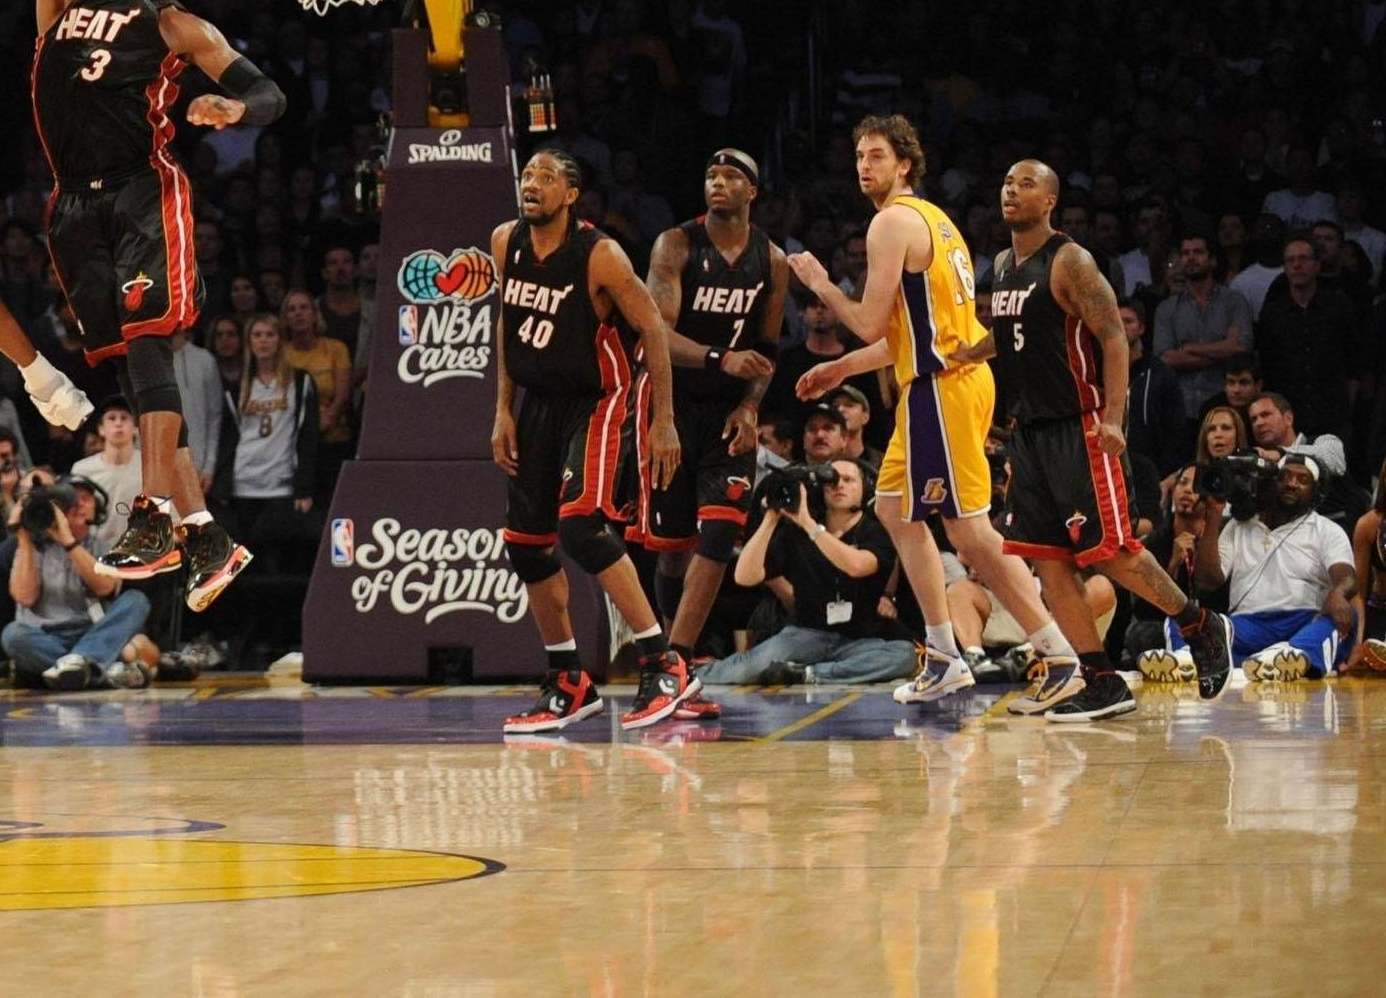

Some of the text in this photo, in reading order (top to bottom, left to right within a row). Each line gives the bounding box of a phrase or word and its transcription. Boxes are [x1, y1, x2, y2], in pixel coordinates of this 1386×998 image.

[55, 8, 141, 43] HEAT
[81, 48, 112, 81] 3
[407, 142, 493, 164] SPALDING
[503, 277, 575, 316] HEAT
[692, 281, 764, 314] HEAT
[991, 282, 1037, 317] HEAT
[418, 304, 492, 346] NBA
[517, 315, 555, 350] 40
[729, 318, 745, 349] 7
[1013, 322, 1025, 352] 5
[397, 343, 491, 384] Cares
[350, 560, 530, 623] of Giving
